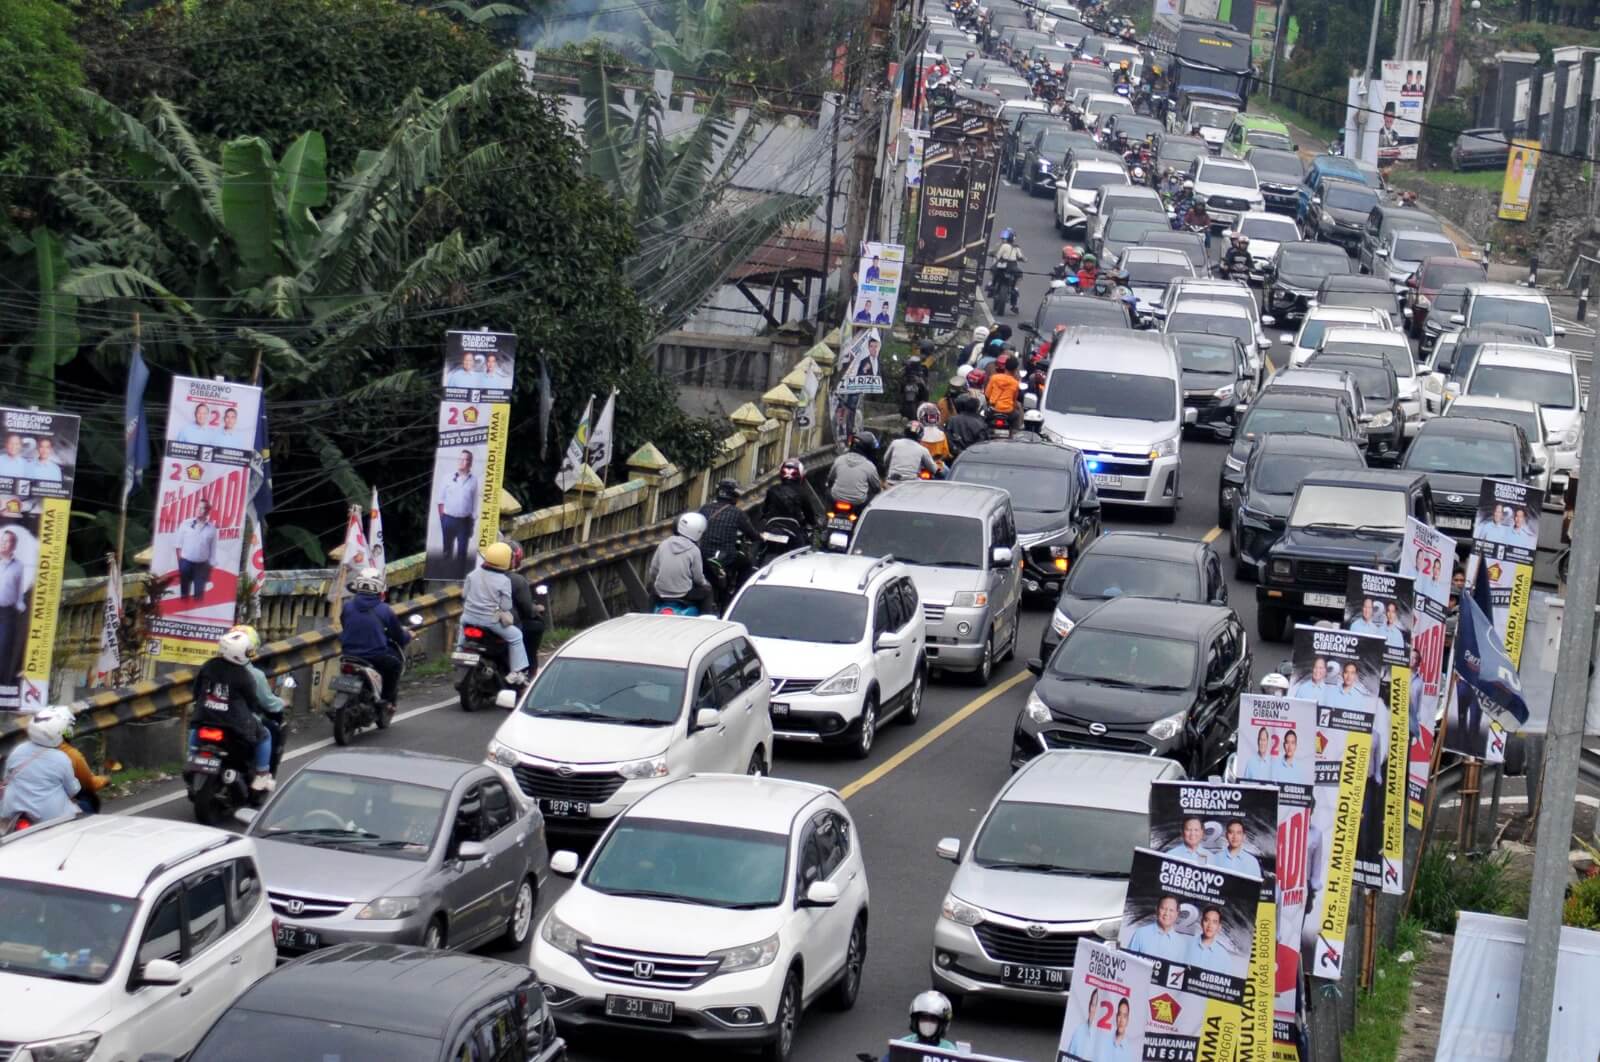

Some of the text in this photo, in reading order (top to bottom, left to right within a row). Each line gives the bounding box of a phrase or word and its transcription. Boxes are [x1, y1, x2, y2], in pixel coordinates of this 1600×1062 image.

[925, 143, 940, 155] NEW
[926, 186, 964, 198] DJARUM
[929, 197, 959, 208] SUPER
[928, 208, 959, 218] ESPRESSO
[462, 334, 497, 342] PRABOWO
[6, 420, 41, 429] GIBRAN
[7, 412, 52, 424] PRABOWO
[208, 411, 220, 426] 2
[448, 407, 458, 425] 2
[490, 411, 500, 442] MMA
[170, 463, 182, 481] 2
[484, 446, 498, 503] MULYADI,
[482, 507, 491, 520] H.
[219, 528, 240, 540] MMA
[479, 523, 489, 547] Drs.
[1423, 558, 1432, 575] 2
[27, 509, 56, 673] Drs. H. MULYADI, MMA
[1505, 611, 1519, 654] LYADI,
[1512, 573, 1524, 607] MMA
[197, 626, 224, 634] MASIH
[1313, 641, 1347, 652] GIBRAN
[1314, 633, 1358, 646] PRABOWO
[1253, 700, 1290, 712] PRABOWO
[1253, 708, 1279, 719] GIBRAN
[1270, 734, 1280, 756] 2
[1355, 747, 1368, 782] BOGOR)
[1385, 678, 1401, 851] Drs. H. MULYADI, MMA
[1180, 787, 1242, 801] PRABOWO
[1180, 798, 1227, 810] GIBRAN
[1322, 743, 1359, 932] Drs. H. MULYADI, MMA
[1346, 816, 1357, 844] JABAR
[1343, 848, 1354, 873] DAPIL
[1160, 861, 1224, 887] PRABOWO
[1159, 873, 1208, 894] GIBRAN
[1339, 886, 1348, 904] DPR
[1176, 903, 1200, 936] 2
[1336, 905, 1347, 935] CALEG
[1259, 919, 1271, 959] BOGOR)
[1320, 952, 1340, 972] 2
[1004, 965, 1010, 977] B
[1017, 967, 1041, 981] 2133
[1200, 972, 1231, 987] GIBRAN
[1259, 962, 1270, 988] (KAB.
[1224, 988, 1240, 997] RAKA
[1096, 1000, 1114, 1031] 2
[1240, 971, 1259, 1062] MULYADI,
[1257, 1000, 1268, 1034] JABAR
[1200, 1015, 1222, 1062] MMA
[1219, 1022, 1236, 1062] BOGOR)
[1147, 1047, 1194, 1062] NESIA
